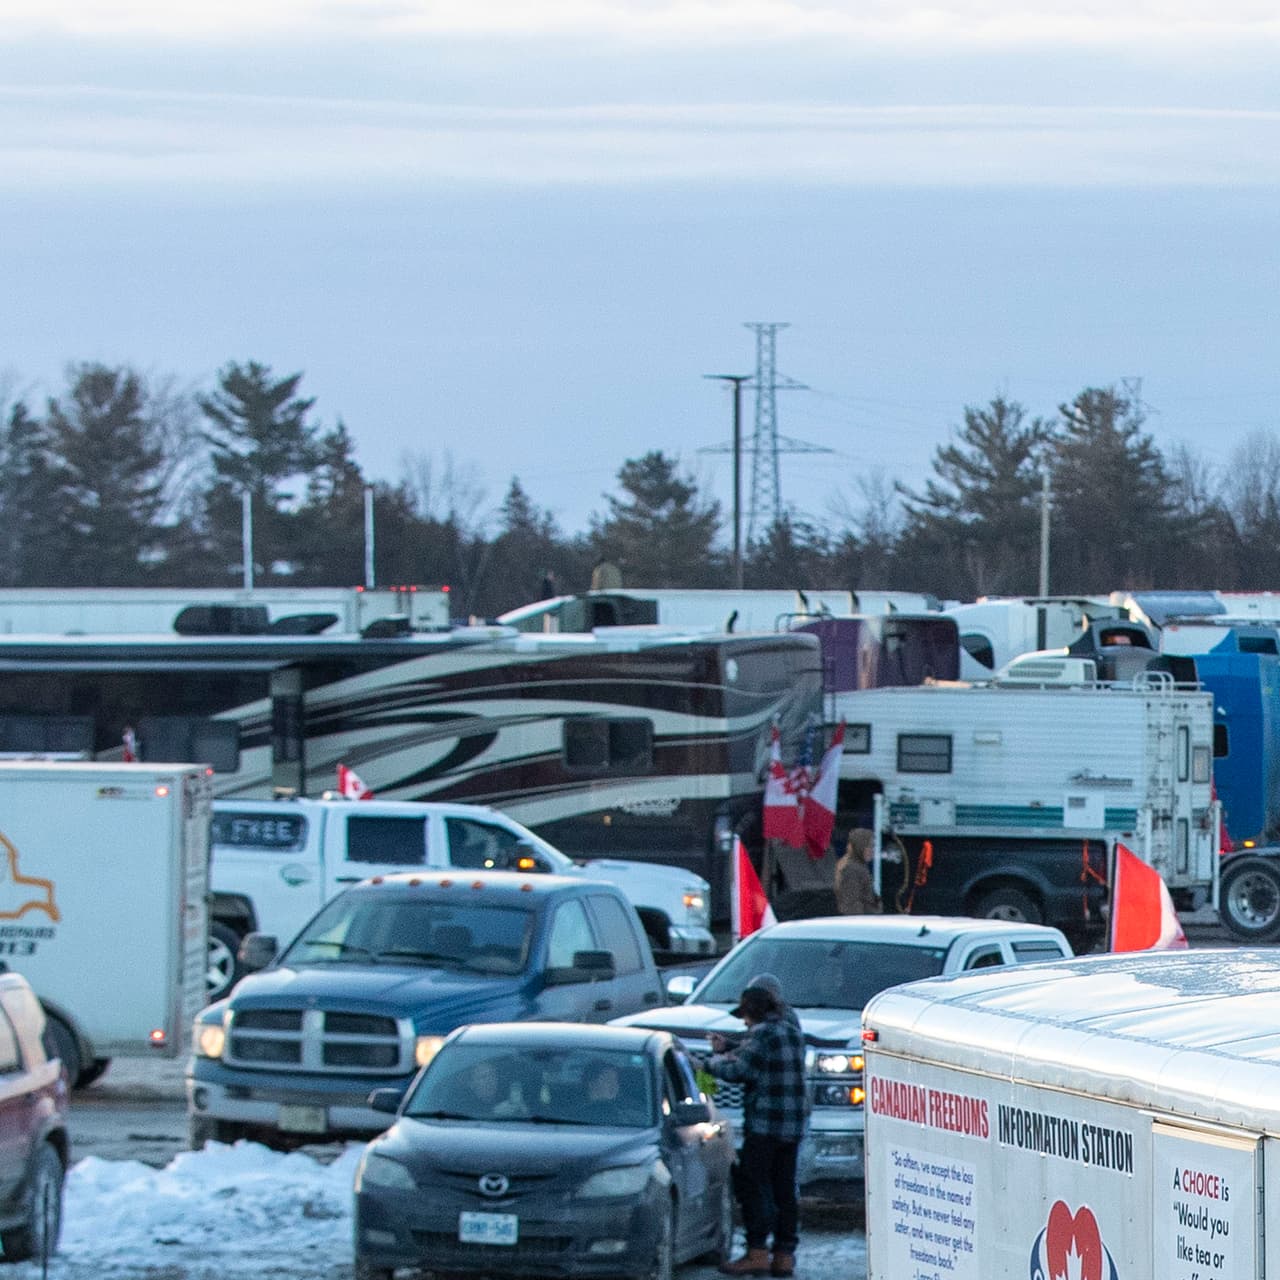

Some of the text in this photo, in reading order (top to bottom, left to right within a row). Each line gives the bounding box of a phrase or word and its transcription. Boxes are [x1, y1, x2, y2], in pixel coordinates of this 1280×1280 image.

[871, 1075, 1134, 1173] CANADIAN FREEDOMS INFORMATION STATION
[1173, 1167, 1230, 1202] A CHOICE is
[1210, 1217, 1230, 1240] you
[1176, 1234, 1225, 1269] like tea or
